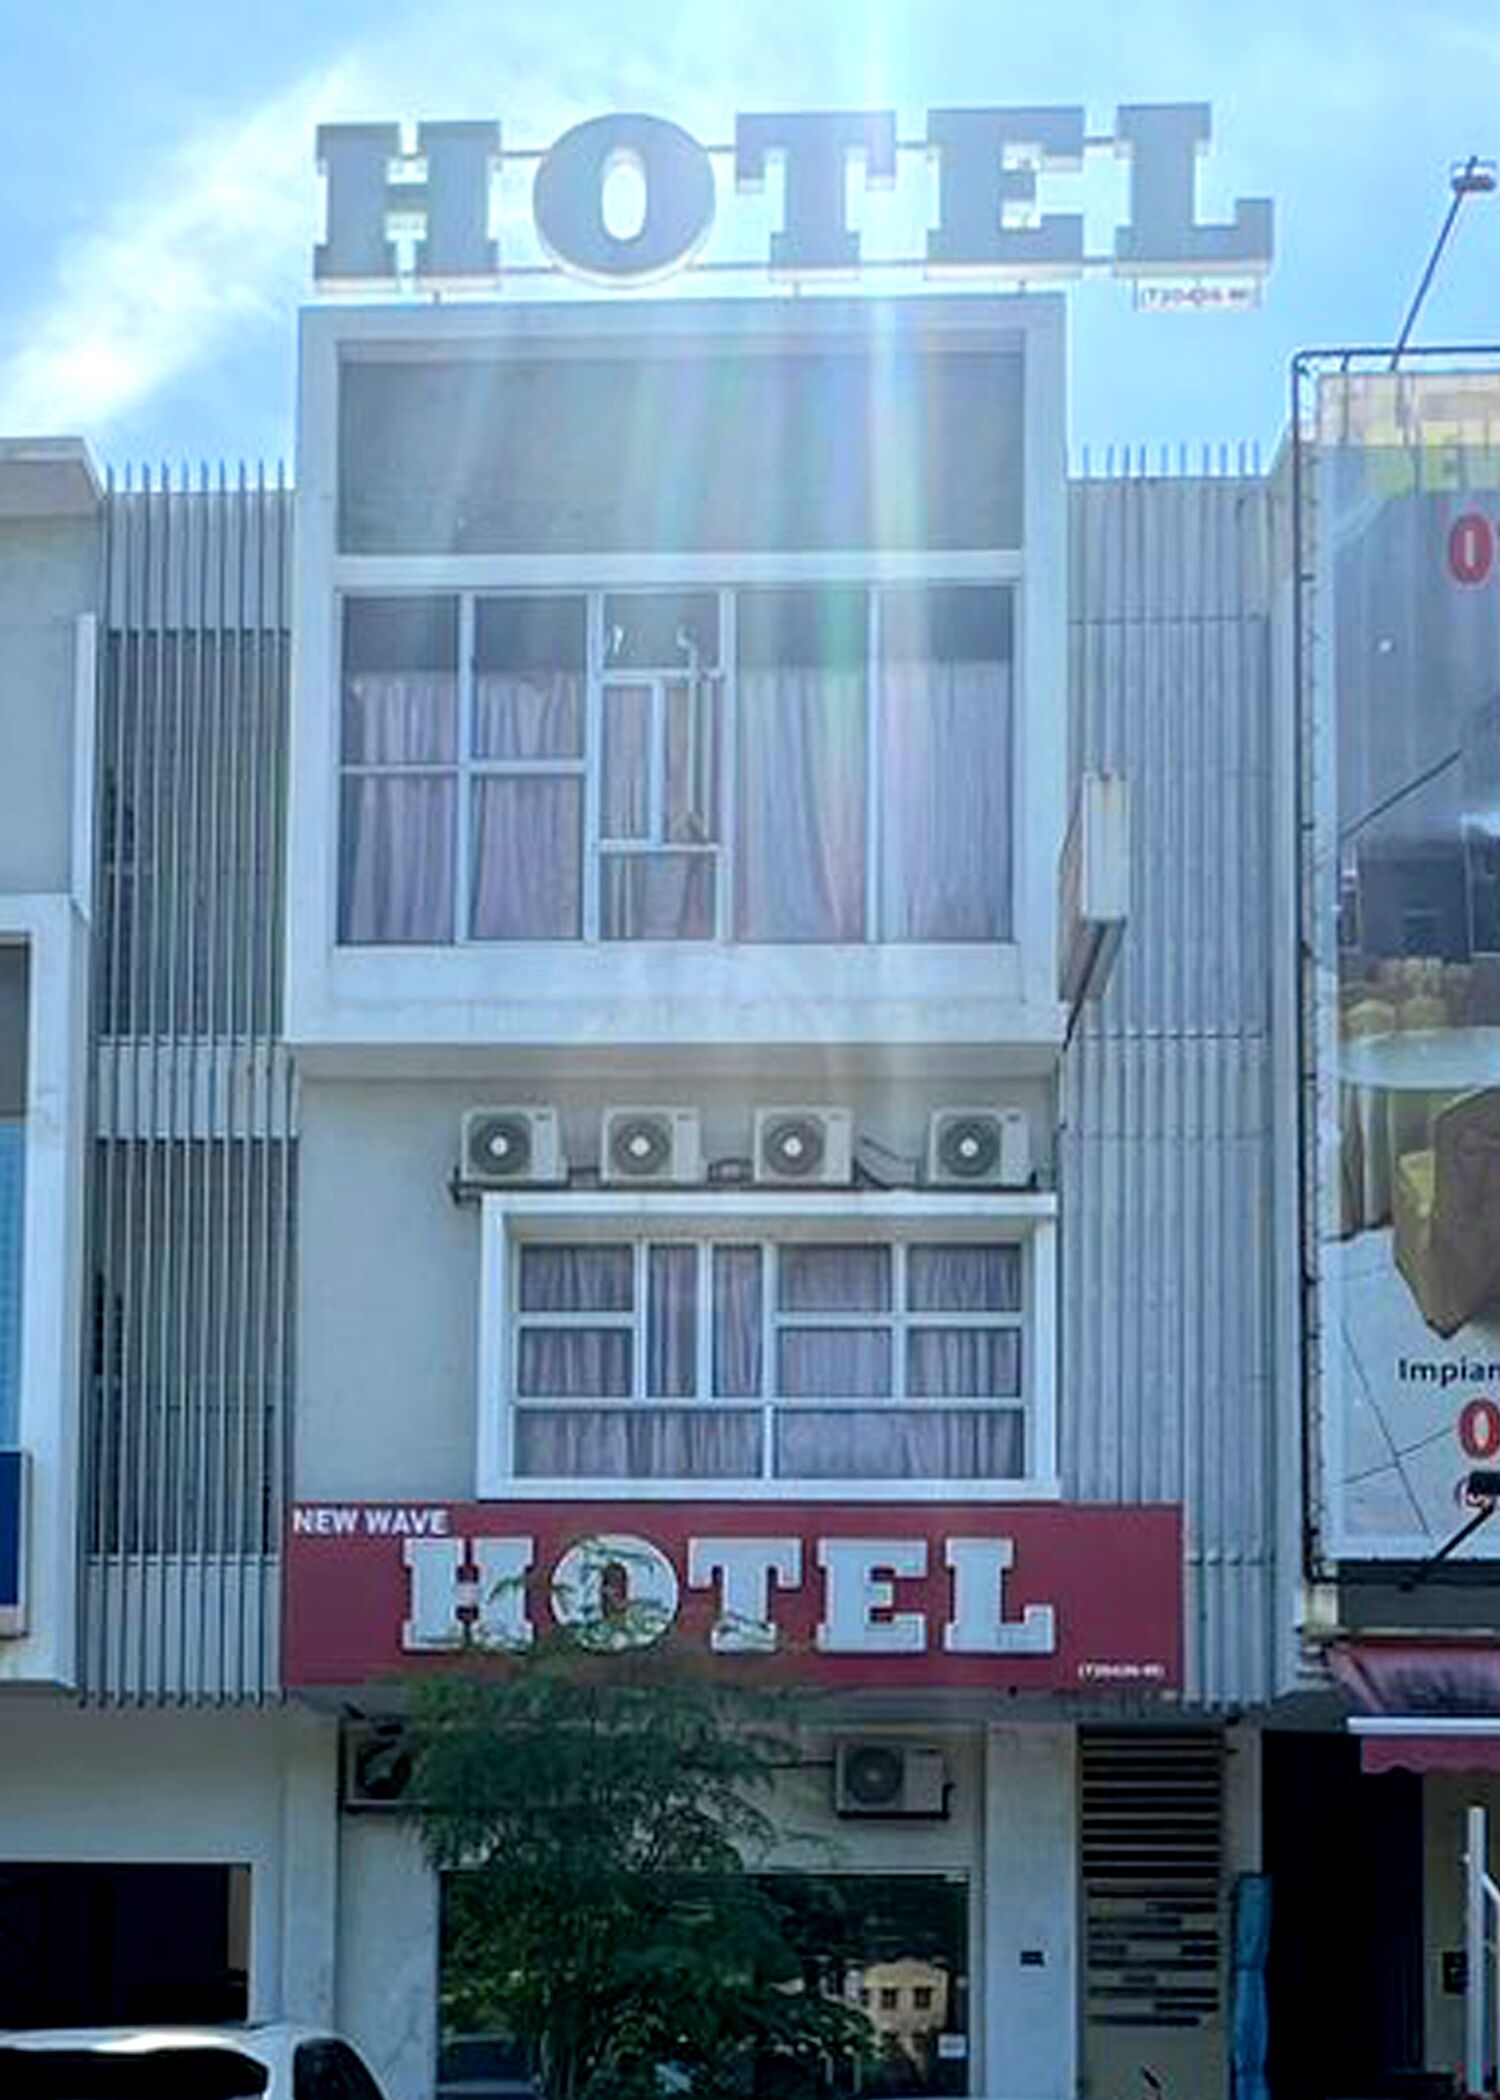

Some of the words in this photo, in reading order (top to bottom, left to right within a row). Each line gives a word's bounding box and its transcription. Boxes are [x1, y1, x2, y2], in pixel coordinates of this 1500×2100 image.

[313, 102, 1273, 286] HOTEL
[293, 1508, 359, 1534] NEW
[364, 1508, 448, 1535] WAVE
[402, 1534, 1056, 1655] HOTEL
